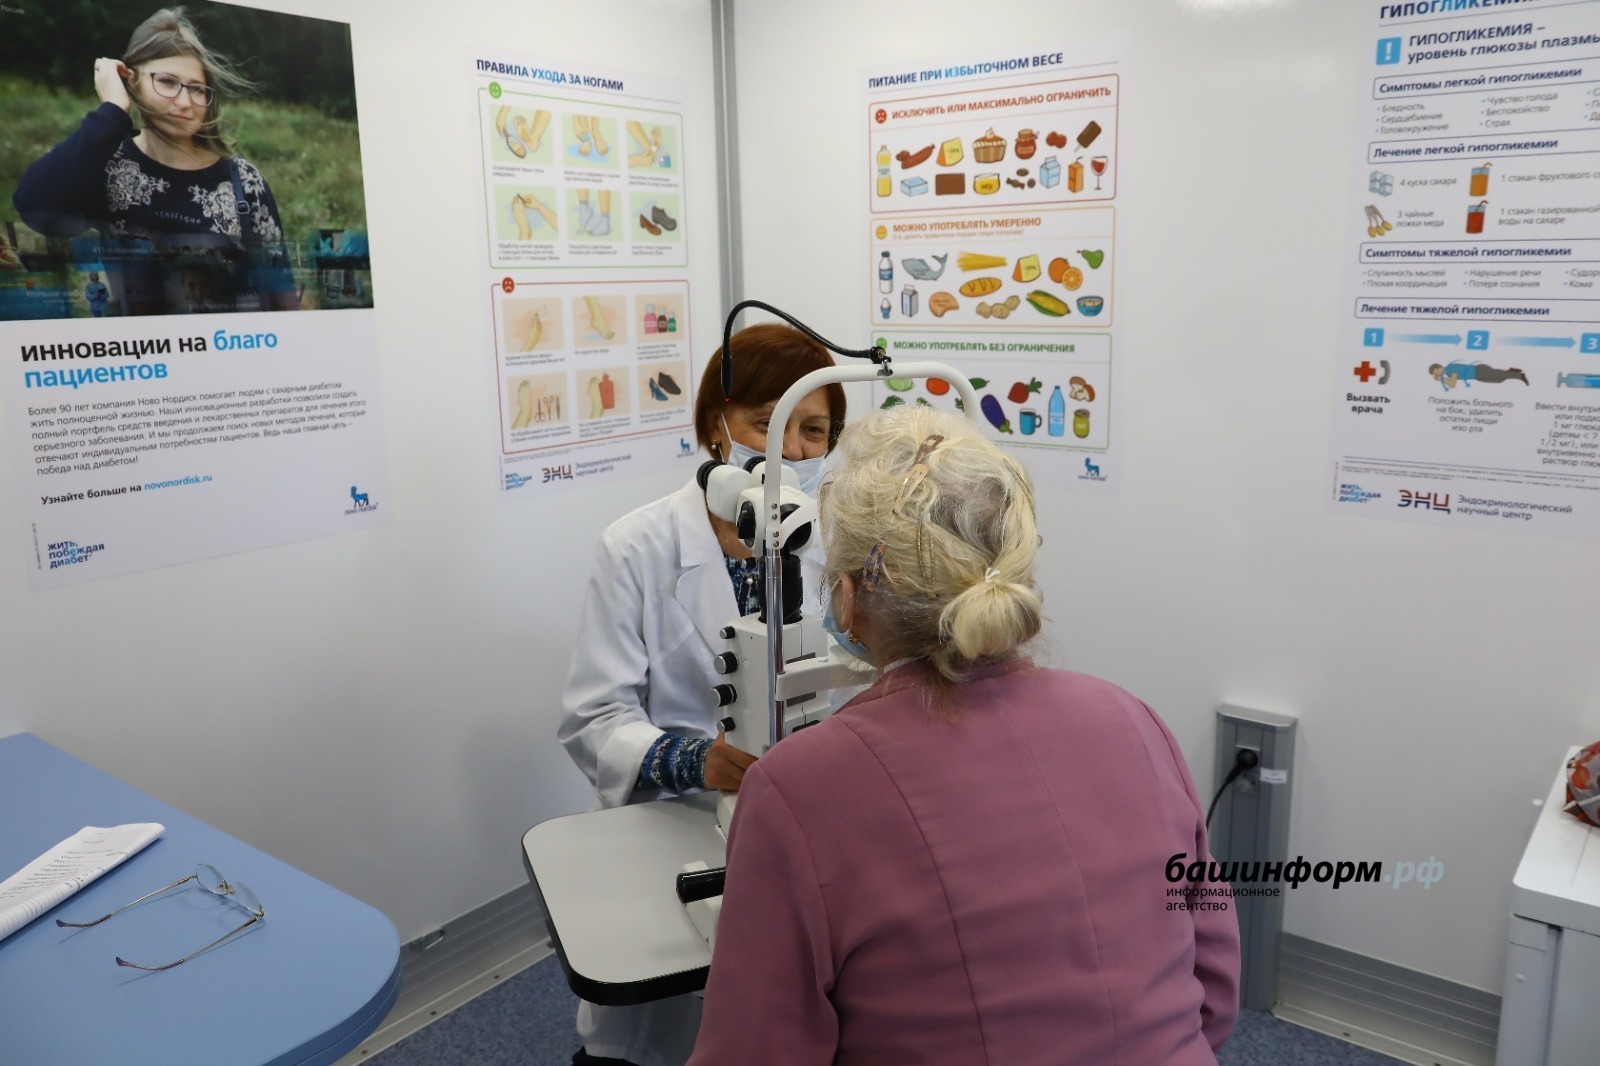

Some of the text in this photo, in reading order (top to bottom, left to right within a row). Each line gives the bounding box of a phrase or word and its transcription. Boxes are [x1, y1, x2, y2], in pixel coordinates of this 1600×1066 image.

[1380, 0, 1541, 19] ГИПОГЛИКЕ
[1409, 23, 1533, 47] ГИПОГЛИКЕМИЯ
[1407, 41, 1537, 64] уровень глюкозы
[476, 59, 624, 91] ПРАВИЛА УХОДА ЗА НОГАМИ
[868, 52, 1064, 89] ПИТАНИЕ ПРИ ИЗБЫТОЧНОМ ВЕСЕ
[1380, 67, 1583, 94] Симптомы легкой гипогликемии
[892, 86, 1112, 120] ИСКЛЮЧИТЬ ИЛИ МАКСИМАЛЬНО ОГРАНИЧИТЬ
[1487, 92, 1558, 106] Чувство голода
[1382, 103, 1425, 113] Бледность
[1486, 105, 1550, 116] Беспокойство
[1381, 113, 1443, 124] Сердцебиение
[1484, 119, 1511, 128] Страх
[1380, 124, 1449, 135] Головокружение
[1373, 139, 1558, 158] Лечение легкой гипогликемии
[1407, 179, 1428, 188] куска
[1429, 178, 1457, 187] сахара
[1538, 172, 1591, 183] фруктового
[1404, 209, 1435, 218] чайные
[1507, 208, 1535, 216] стакан
[893, 216, 1042, 233] МОЖНО УПОТРЕБЛЯТЬ УМЕРЕННО
[1396, 219, 1444, 228] ложки меда
[1498, 218, 1521, 226] воды
[1536, 216, 1566, 226] сахаре
[1366, 247, 1572, 259] Симптомы тяжелой гипогликемии
[1368, 268, 1446, 278] Спутанность мыслей
[1470, 268, 1541, 278] Нарушение речи
[1367, 279, 1447, 289] Плохая координация
[1469, 279, 1540, 288] Потеря сознания
[1569, 279, 1593, 288] Кома
[1361, 303, 1549, 317] Лечение тяжелой гипогликемии
[1371, 333, 1377, 343] 1
[1473, 334, 1483, 346] 2
[1588, 338, 1598, 349] 3
[20, 329, 278, 362] инновации на благо
[893, 340, 1075, 353] МОЖНО УПОТРЕБЛЯТЬ БЕЗ ОГРАНИЧЕНИЯ
[24, 362, 168, 388] пациентов
[28, 406, 57, 416] Более
[59, 404, 71, 413] 90
[74, 404, 89, 412] лет
[92, 400, 136, 410] компания
[137, 397, 160, 406] Ново
[162, 395, 197, 406] Нордиск
[199, 391, 236, 401] помогает
[238, 388, 264, 398] людям
[272, 385, 307, 395] сахарным
[308, 381, 342, 392] диабетом
[1346, 393, 1391, 404] Вызвать
[1428, 396, 1513, 409] Положить больного
[30, 390, 358, 429] жить полноценной жизнью. Наши инновационные разработки позволили создать
[1351, 404, 1383, 415] врача
[1468, 407, 1504, 417] удалить
[1535, 402, 1566, 411] Ввести
[32, 428, 69, 440] полный
[70, 424, 116, 438] портфель
[117, 421, 151, 432] средств
[153, 417, 192, 428] введения
[202, 411, 260, 425] лекарственных
[262, 405, 304, 418] препаратов
[305, 404, 318, 414] для
[320, 401, 347, 411] лечения
[349, 399, 367, 409] этого
[1439, 414, 1498, 426] остатки пищи
[33, 440, 86, 453] серьезного
[88, 433, 146, 446] заболевания.
[149, 431, 156, 439] И
[158, 430, 171, 439] мы
[173, 424, 224, 439] продолжаем
[226, 421, 249, 431] поиск
[250, 419, 273, 429] новых
[275, 415, 306, 427] методов
[339, 409, 366, 420] которые
[1469, 425, 1483, 434] рта
[35, 452, 79, 465] отвечают
[82, 443, 157, 459] индивидуальным
[159, 435, 218, 450] потребностям
[219, 430, 261, 443] пациентов.
[263, 428, 281, 438] Ведь
[282, 426, 301, 435] наша
[303, 422, 330, 433] главная
[1537, 448, 1596, 459] внутривенно
[37, 456, 139, 476] победа над диабетом!
[1542, 457, 1579, 467] раствор
[40, 474, 213, 506] Узнайте больше на novonordisk.ru
[1458, 495, 1573, 514] Эндокринологический
[1457, 505, 1533, 522] научный центр
[48, 540, 78, 551] жить,
[49, 543, 105, 560] побеждая
[50, 554, 90, 570] диабет
